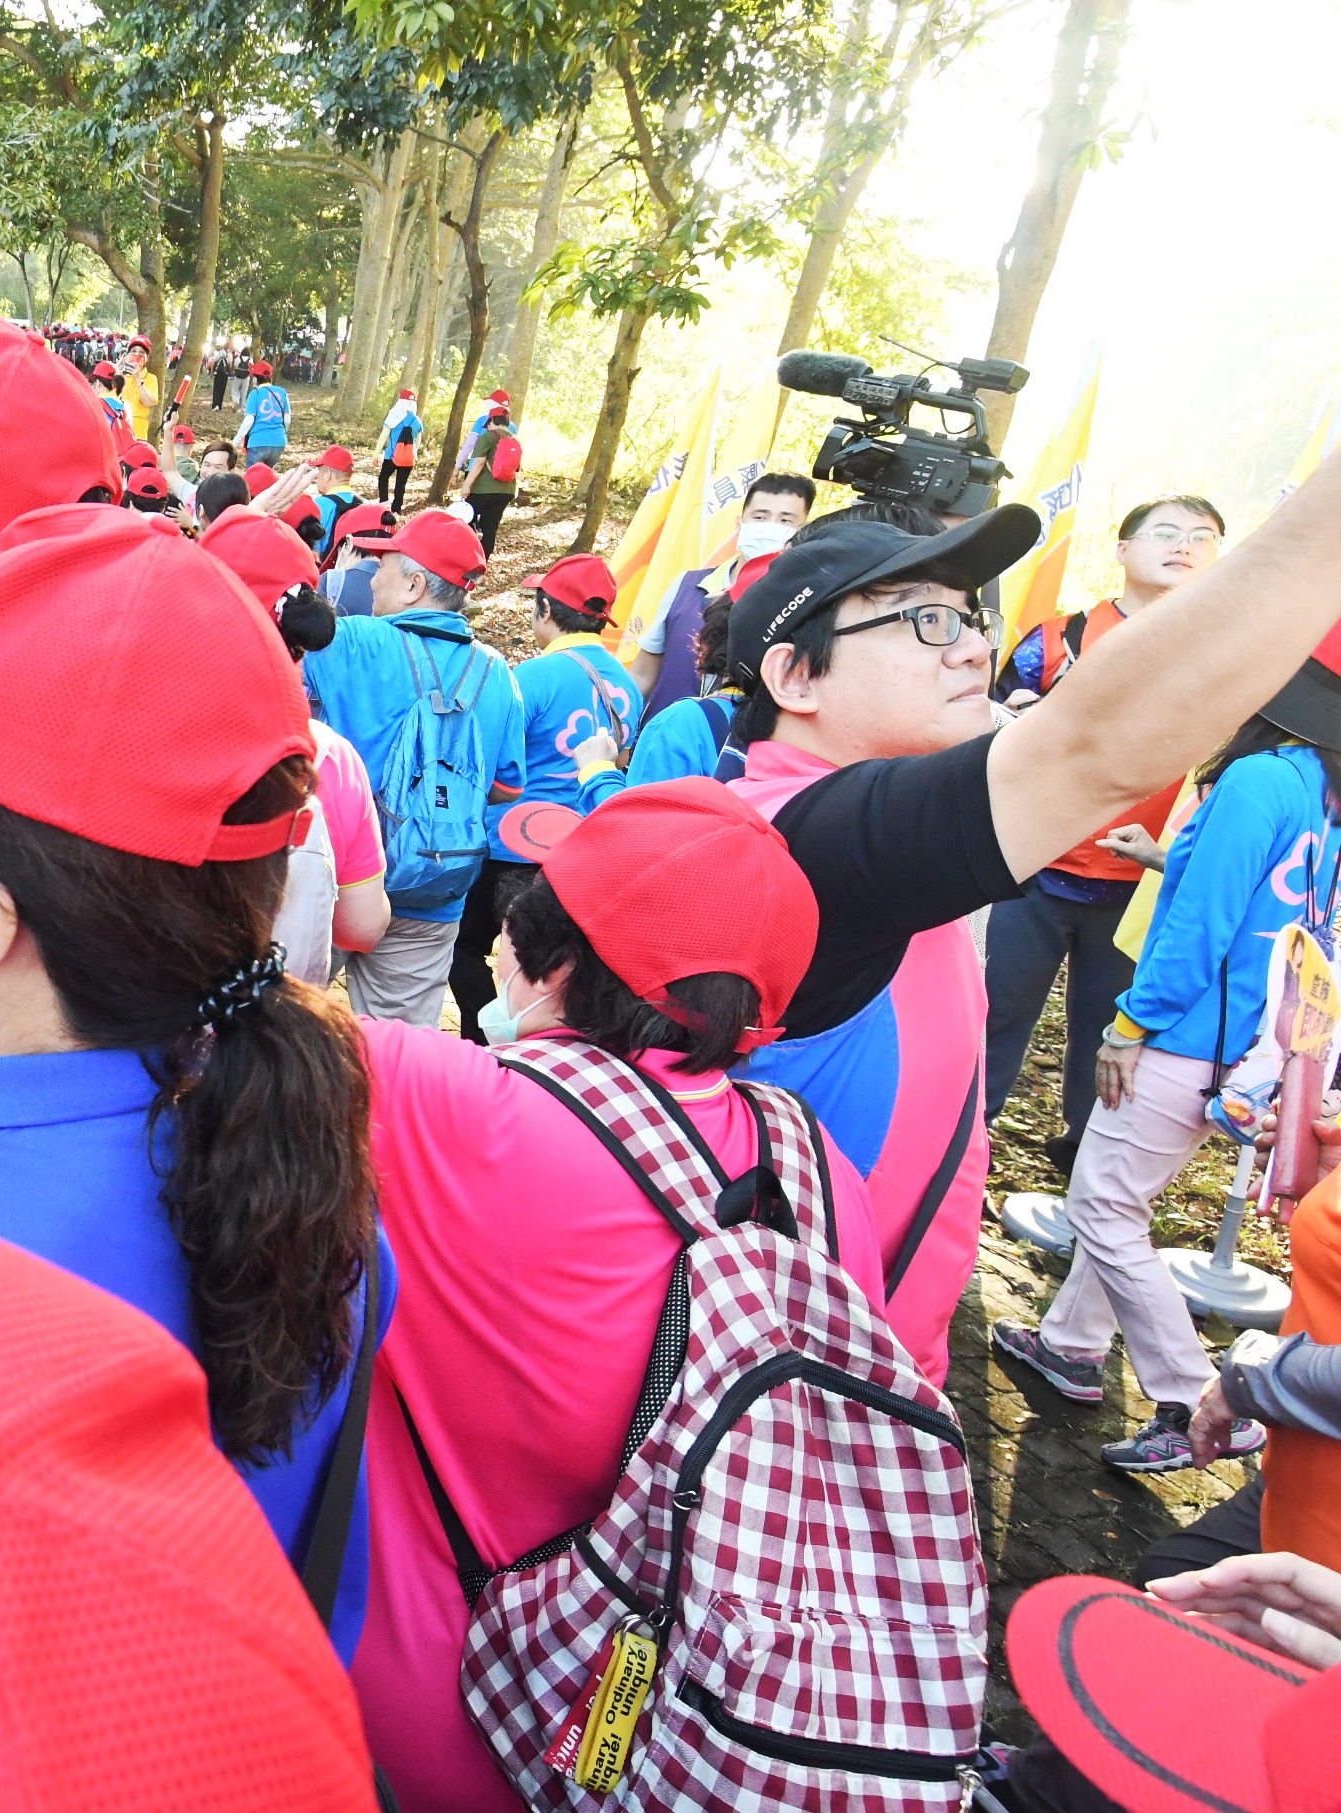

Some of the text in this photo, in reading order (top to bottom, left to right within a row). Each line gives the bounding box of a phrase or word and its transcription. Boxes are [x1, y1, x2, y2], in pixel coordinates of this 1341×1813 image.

[762, 586, 814, 643] LIFECODE
[605, 1645, 638, 1725] Ordinary
[620, 1642, 649, 1717] unique
